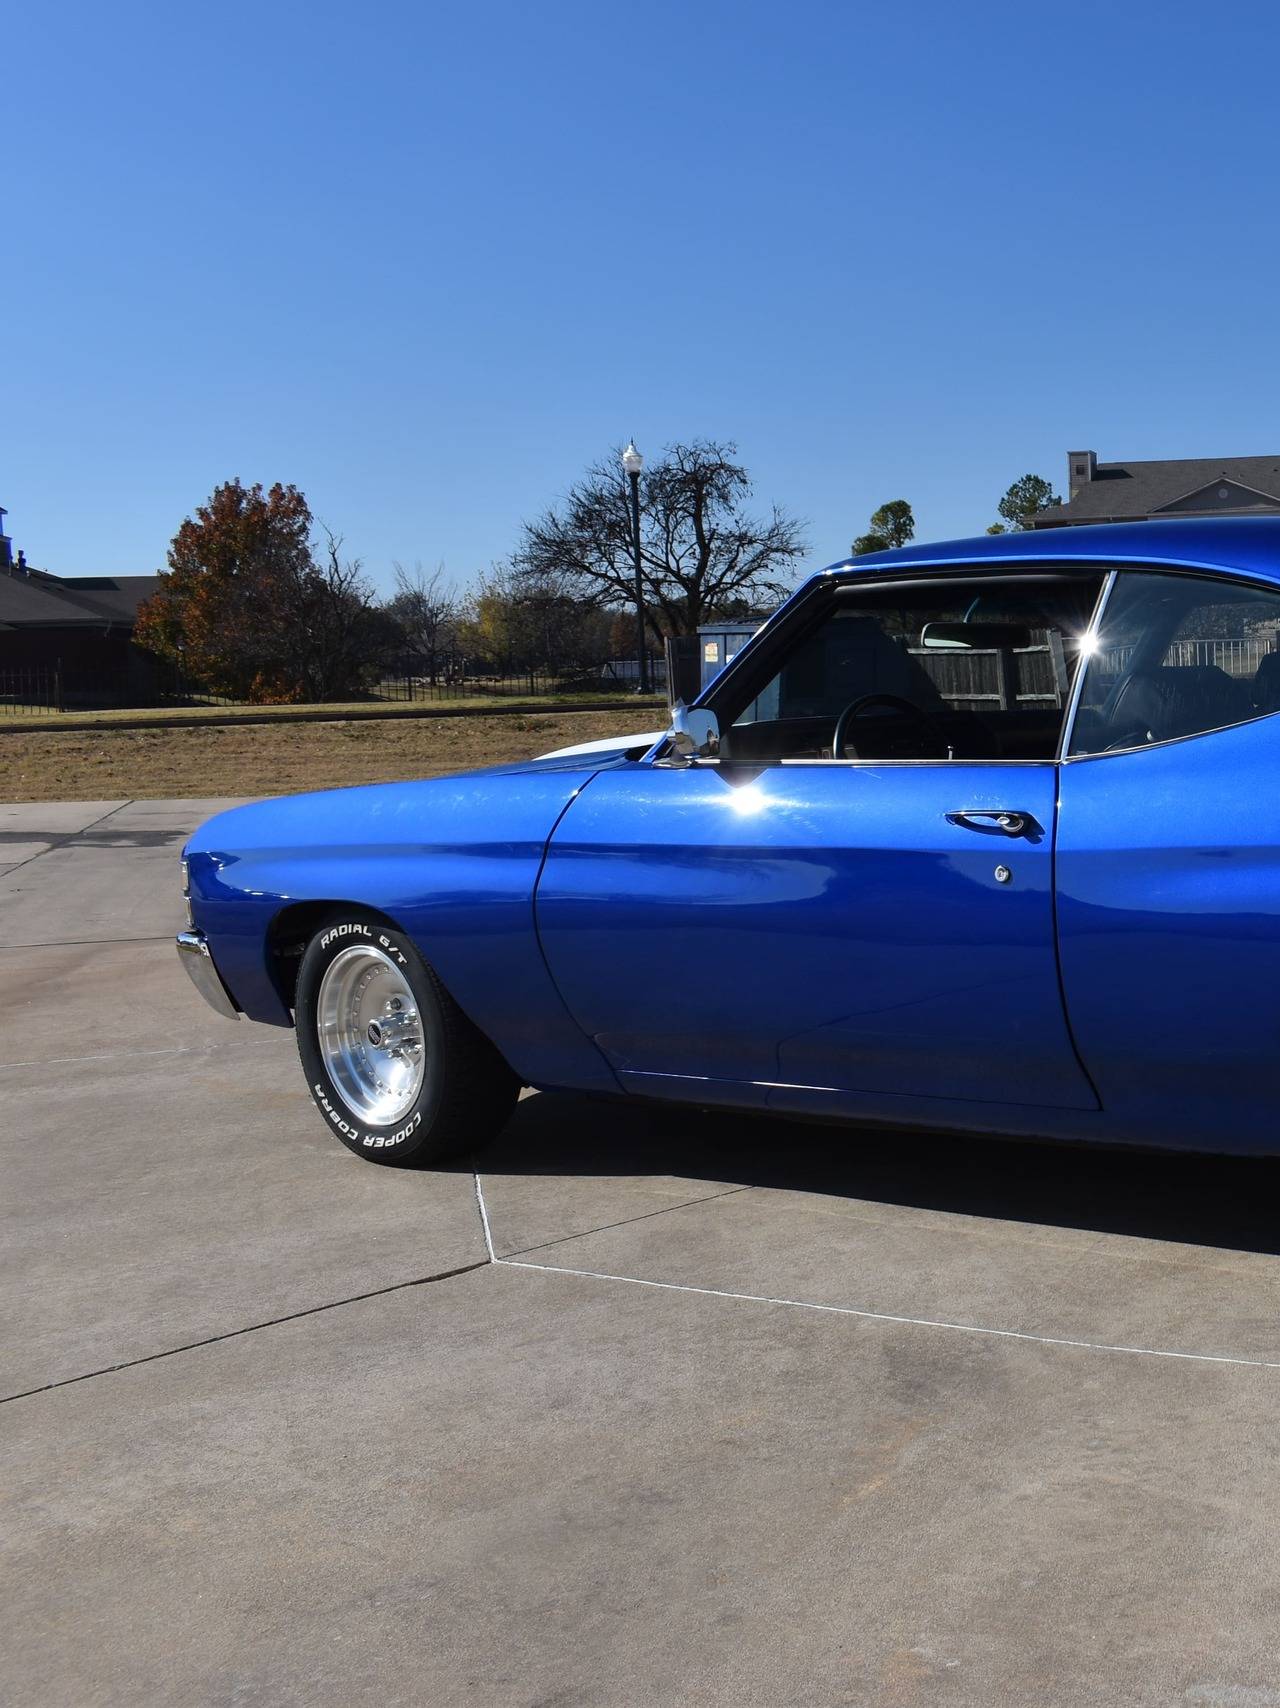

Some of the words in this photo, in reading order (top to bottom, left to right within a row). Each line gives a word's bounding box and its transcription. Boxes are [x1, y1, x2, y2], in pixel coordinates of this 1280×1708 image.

[320, 924, 372, 949] RADIAL
[379, 935, 408, 964] G/T
[314, 1084, 358, 1140] COBRA
[363, 1111, 422, 1148] COOPER
